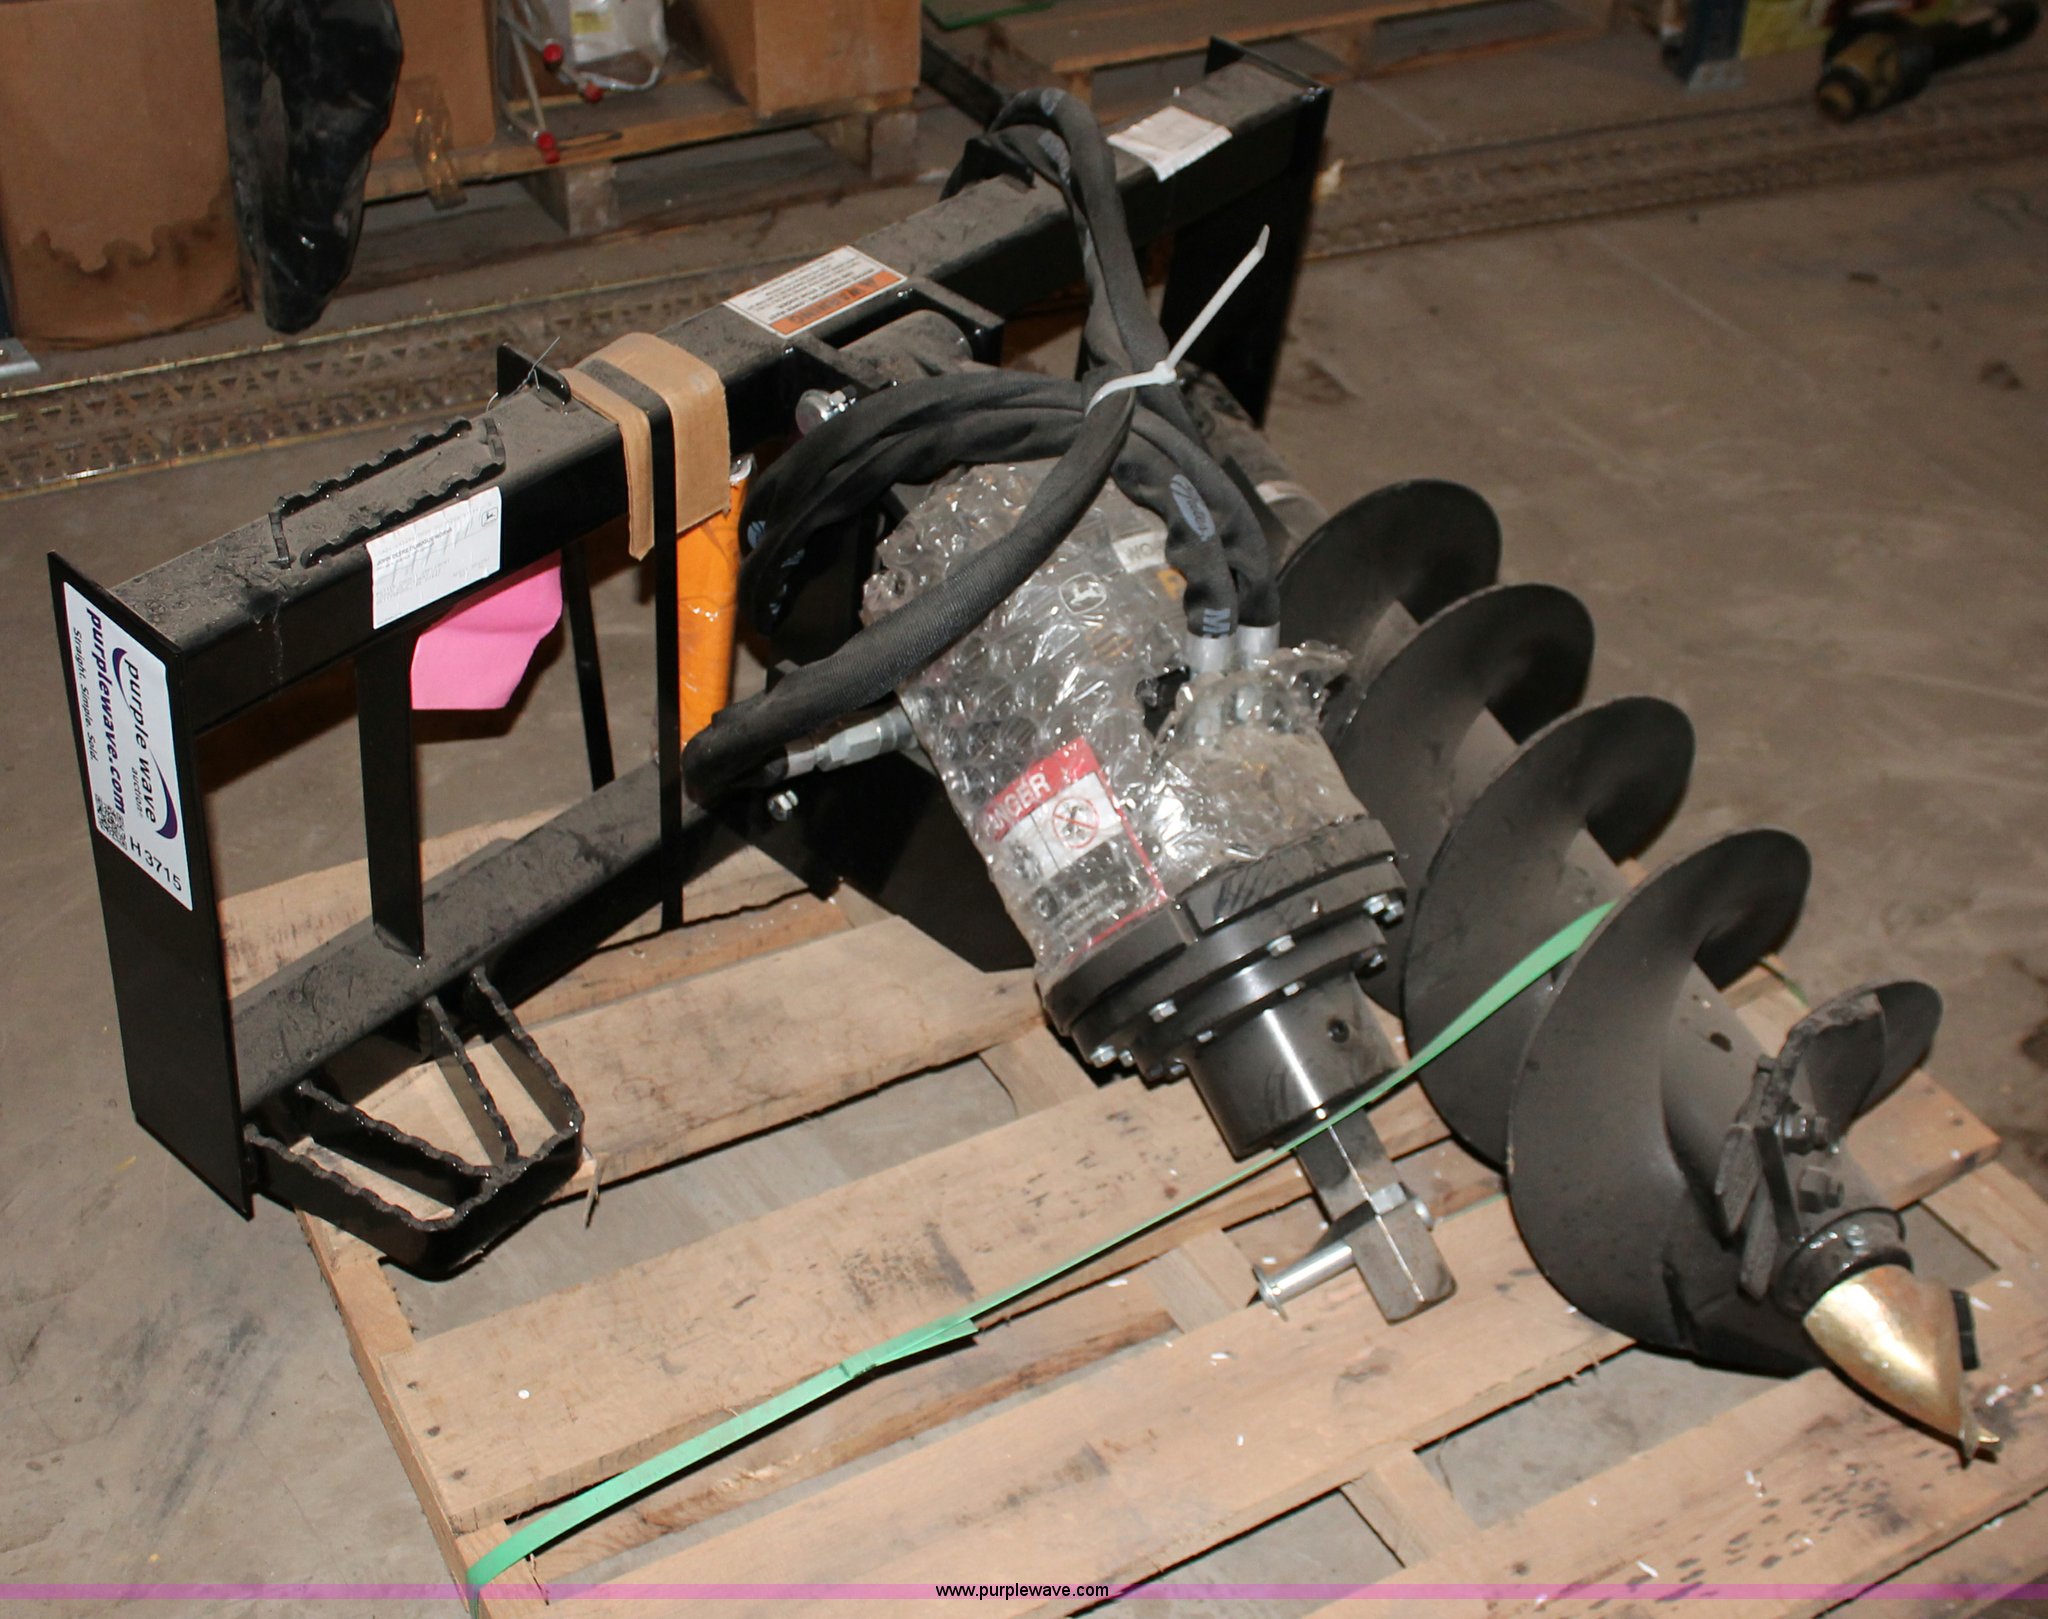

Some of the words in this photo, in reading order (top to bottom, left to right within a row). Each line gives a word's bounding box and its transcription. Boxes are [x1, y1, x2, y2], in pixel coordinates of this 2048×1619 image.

[73, 627, 87, 679] Straight.
[80, 683, 94, 728] Simple.
[87, 731, 99, 762] Sold.
[86, 607, 126, 814] purplewave.com
[124, 658, 149, 749] purple
[139, 757, 157, 823] wave
[144, 850, 182, 892] 3715
